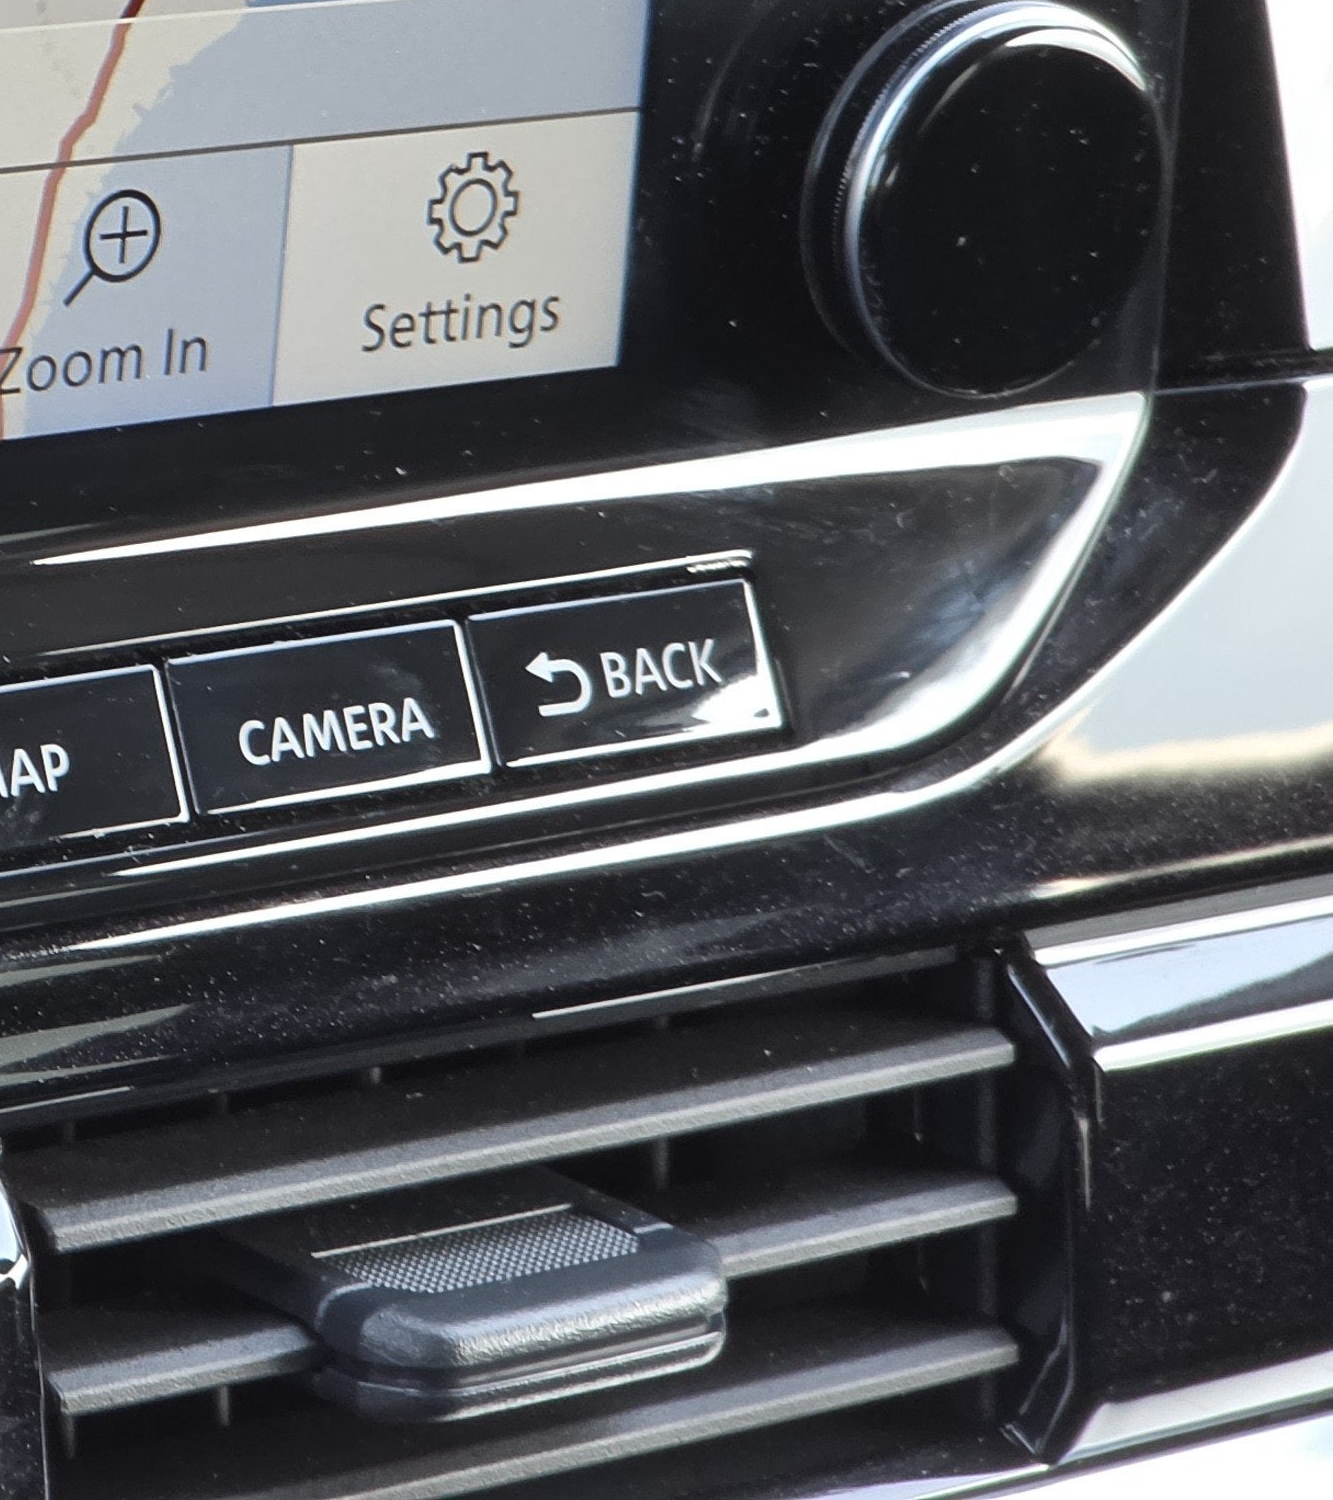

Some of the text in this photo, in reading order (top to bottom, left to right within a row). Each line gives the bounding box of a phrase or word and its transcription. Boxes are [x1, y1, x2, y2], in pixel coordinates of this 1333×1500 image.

[162, 326, 209, 376] In
[360, 292, 561, 354] Settings
[599, 638, 723, 700] BACK
[238, 696, 434, 767] CAMERA
